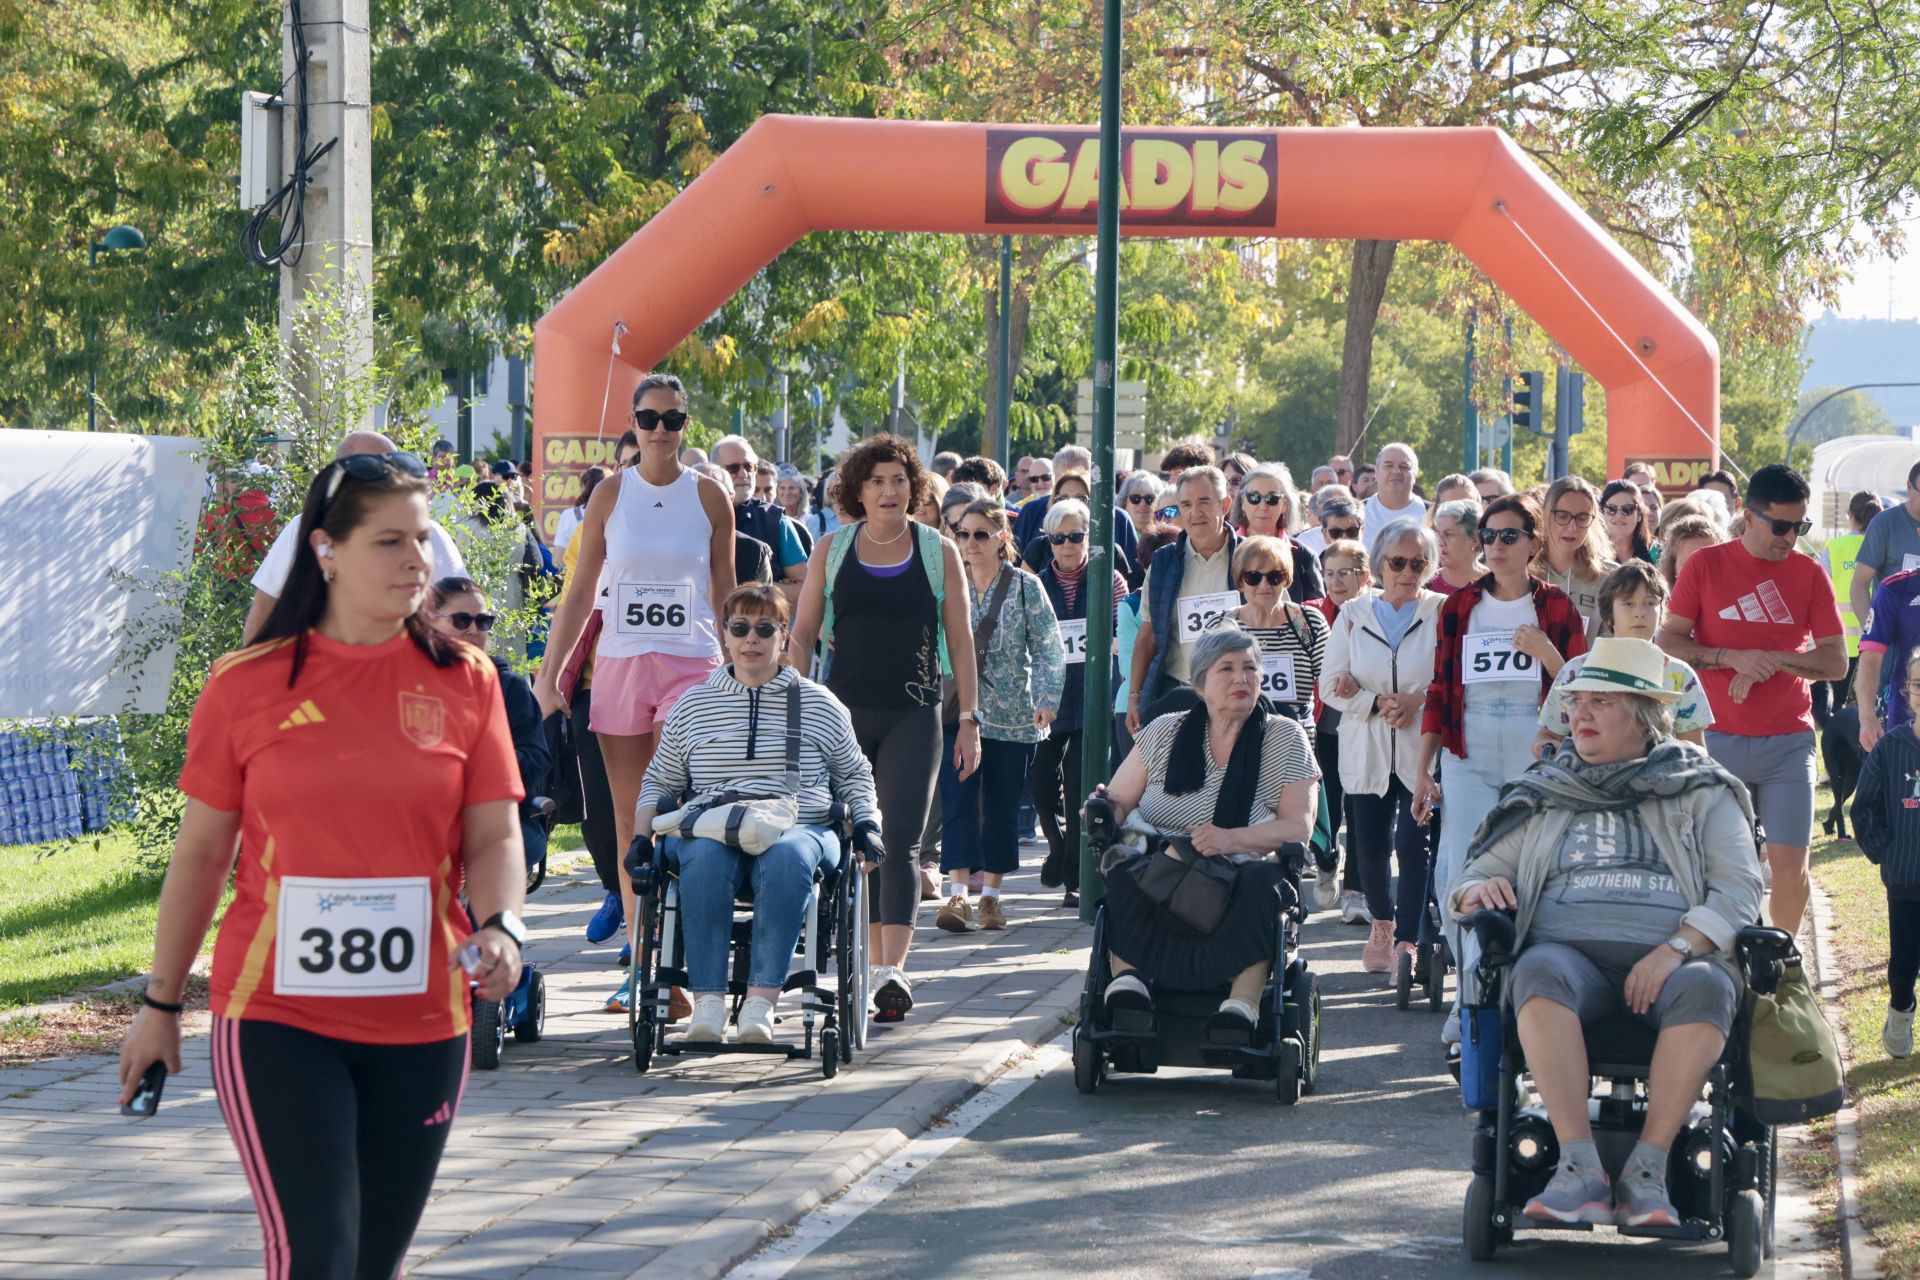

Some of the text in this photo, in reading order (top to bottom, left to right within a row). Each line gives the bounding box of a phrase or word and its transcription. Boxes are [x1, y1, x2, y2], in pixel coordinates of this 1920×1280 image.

[999, 137, 1269, 214] GADIS
[546, 440, 618, 464] GADI
[1653, 462, 1710, 486] ADI
[626, 603, 686, 627] 566
[1473, 651, 1533, 672] 570
[1573, 873, 1642, 889] SOUTHERN
[298, 927, 414, 974] 380
